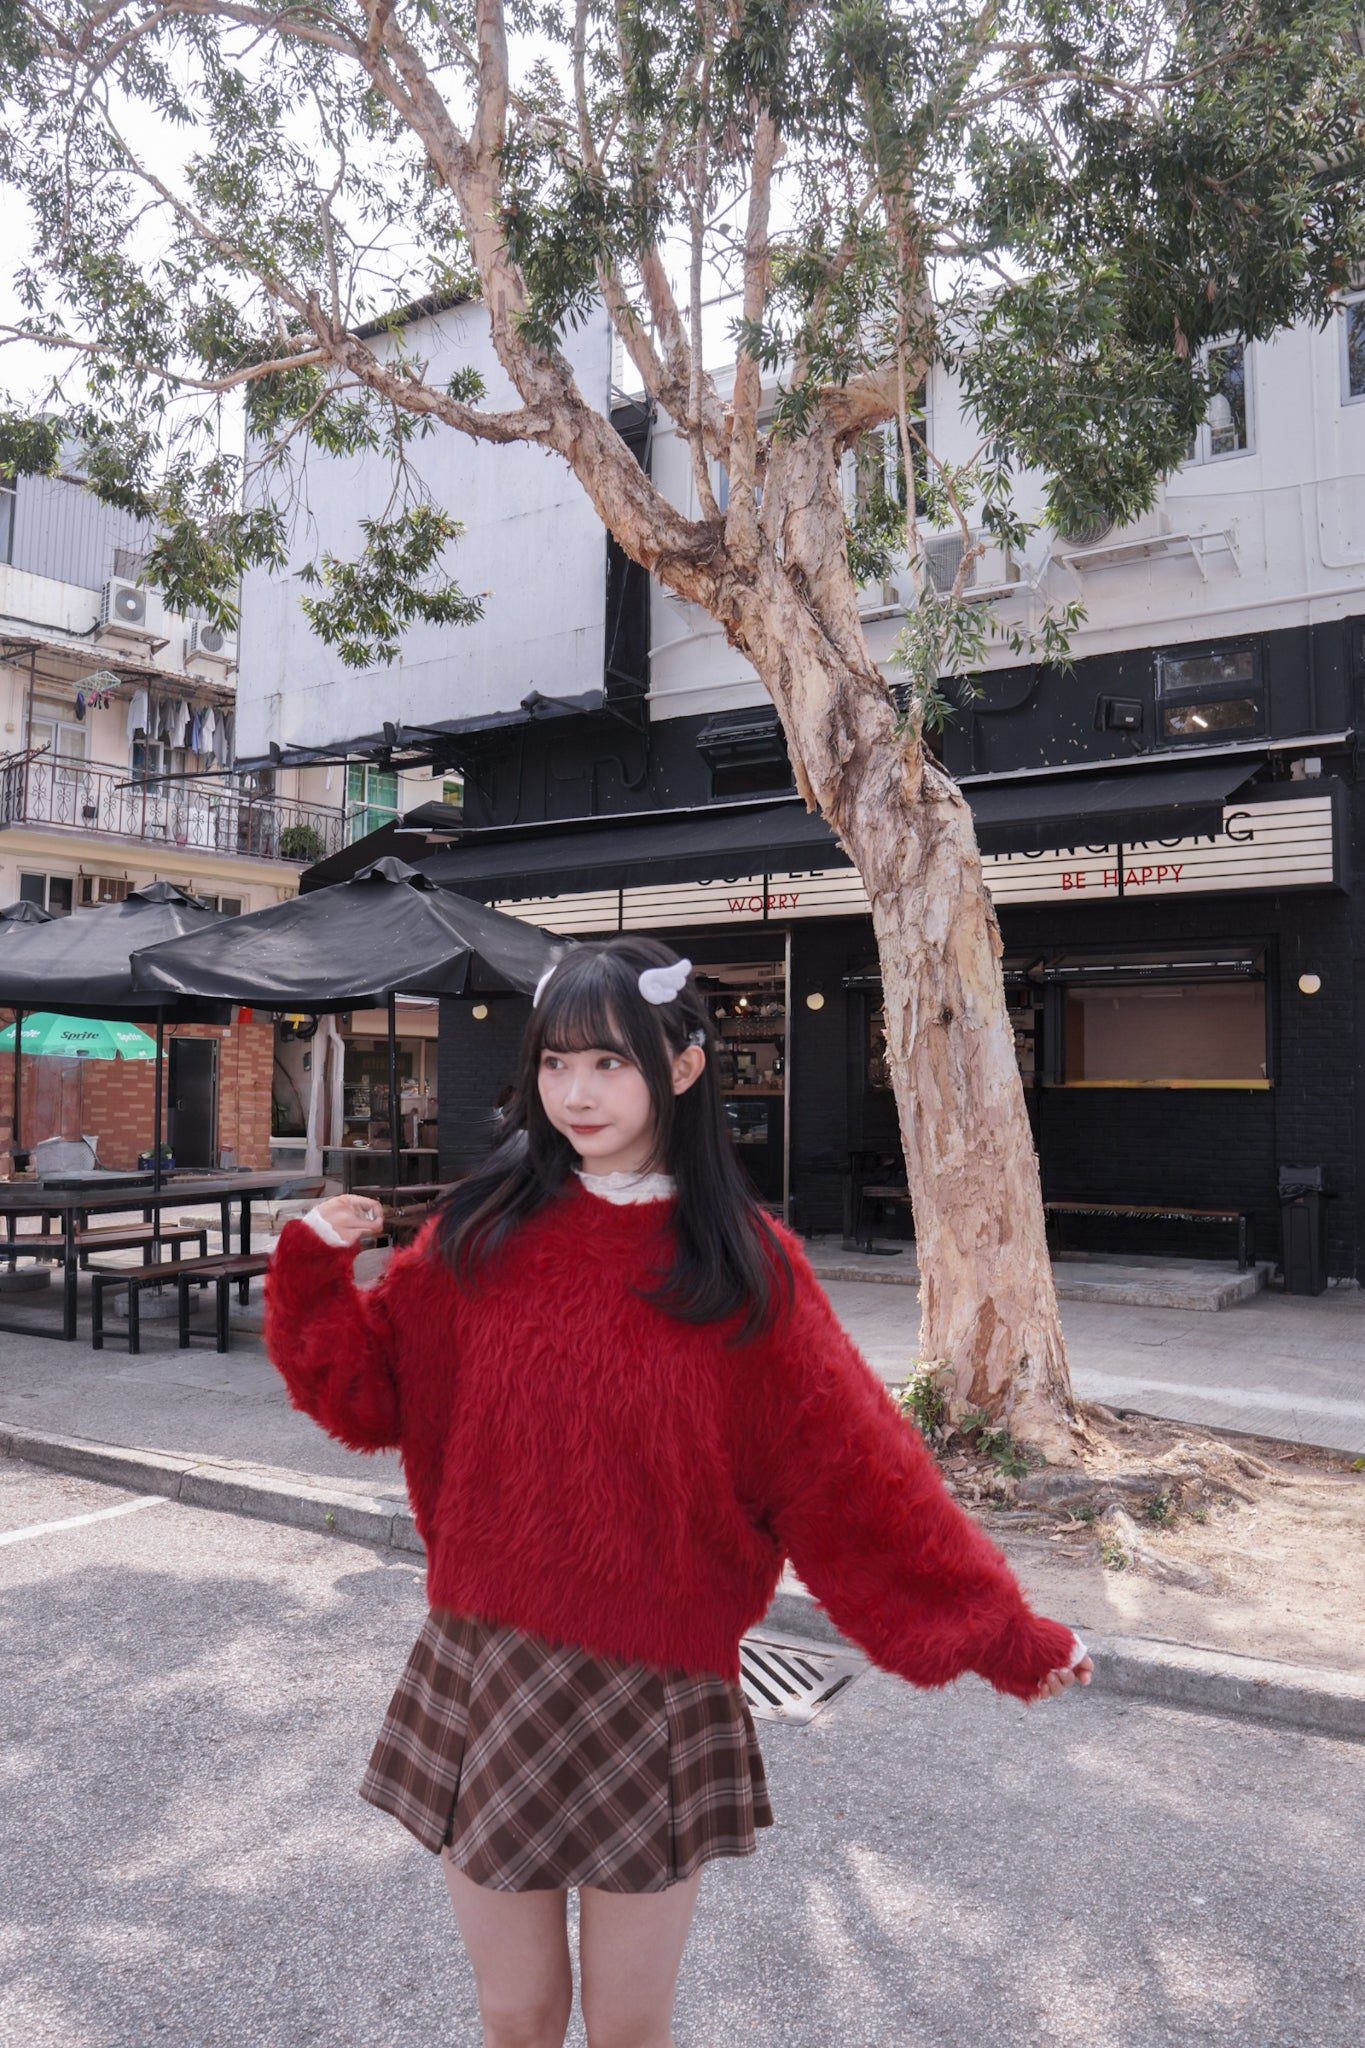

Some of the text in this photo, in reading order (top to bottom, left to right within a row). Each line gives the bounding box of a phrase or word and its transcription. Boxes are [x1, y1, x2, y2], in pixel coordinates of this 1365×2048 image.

[727, 864, 1184, 913] WORRY BE HAPPY
[60, 1031, 99, 1041] Sprite
